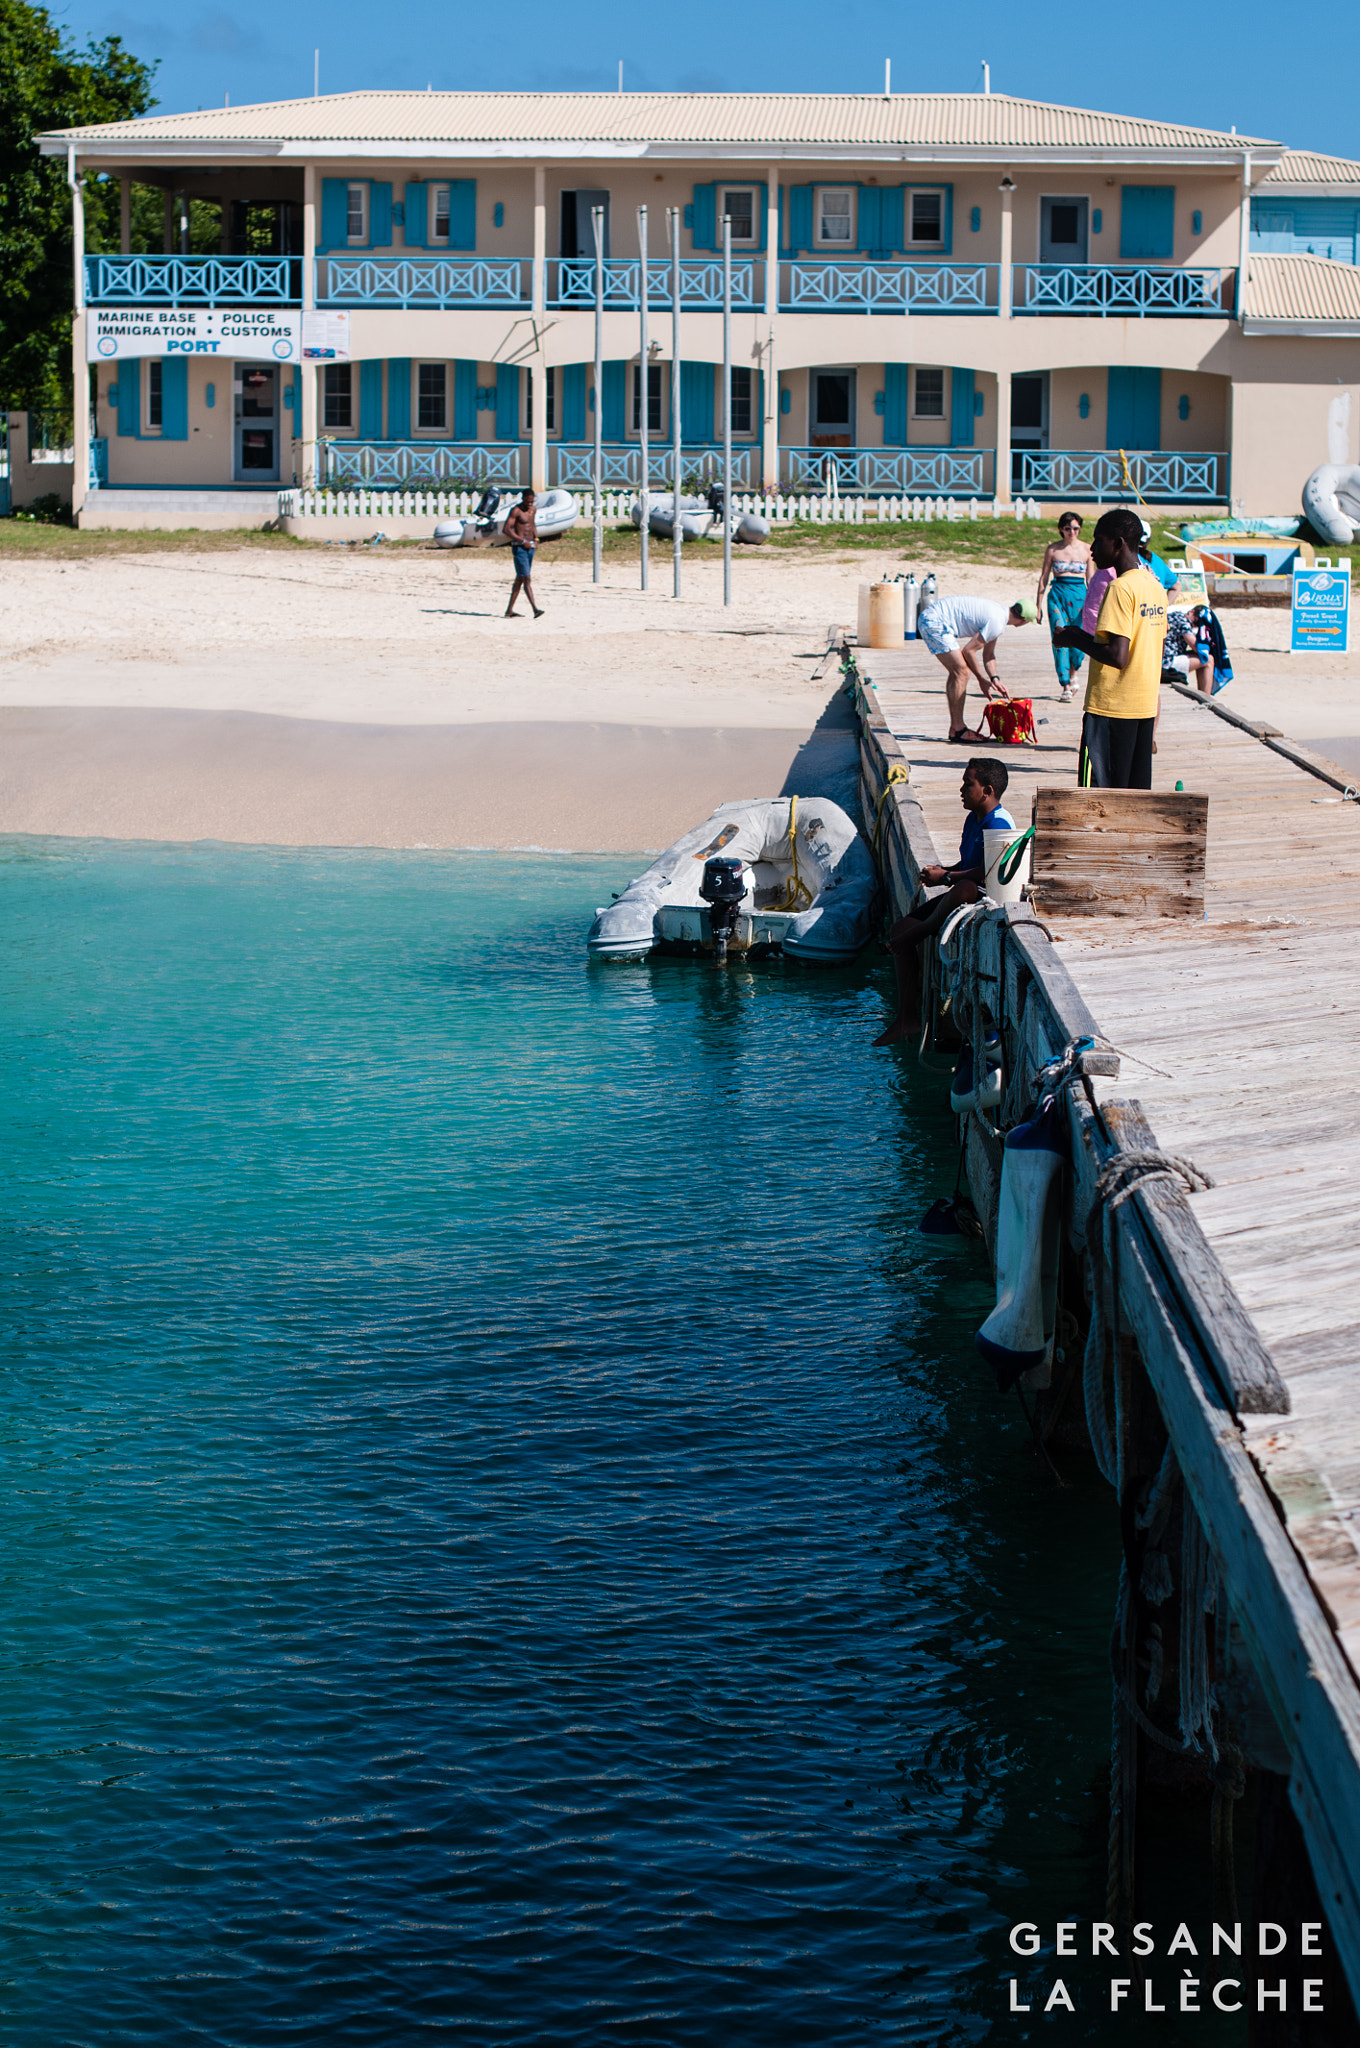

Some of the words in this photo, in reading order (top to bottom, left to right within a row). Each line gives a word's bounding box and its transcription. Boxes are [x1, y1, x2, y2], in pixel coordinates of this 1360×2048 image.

[98, 312, 154, 323] MARINE
[159, 313, 196, 323] BASE
[222, 314, 276, 324] POLICE
[97, 326, 197, 336] IMMIGRATION
[220, 326, 292, 337] CUSTOMS
[167, 340, 221, 353] PORT
[714, 875, 722, 887] 5
